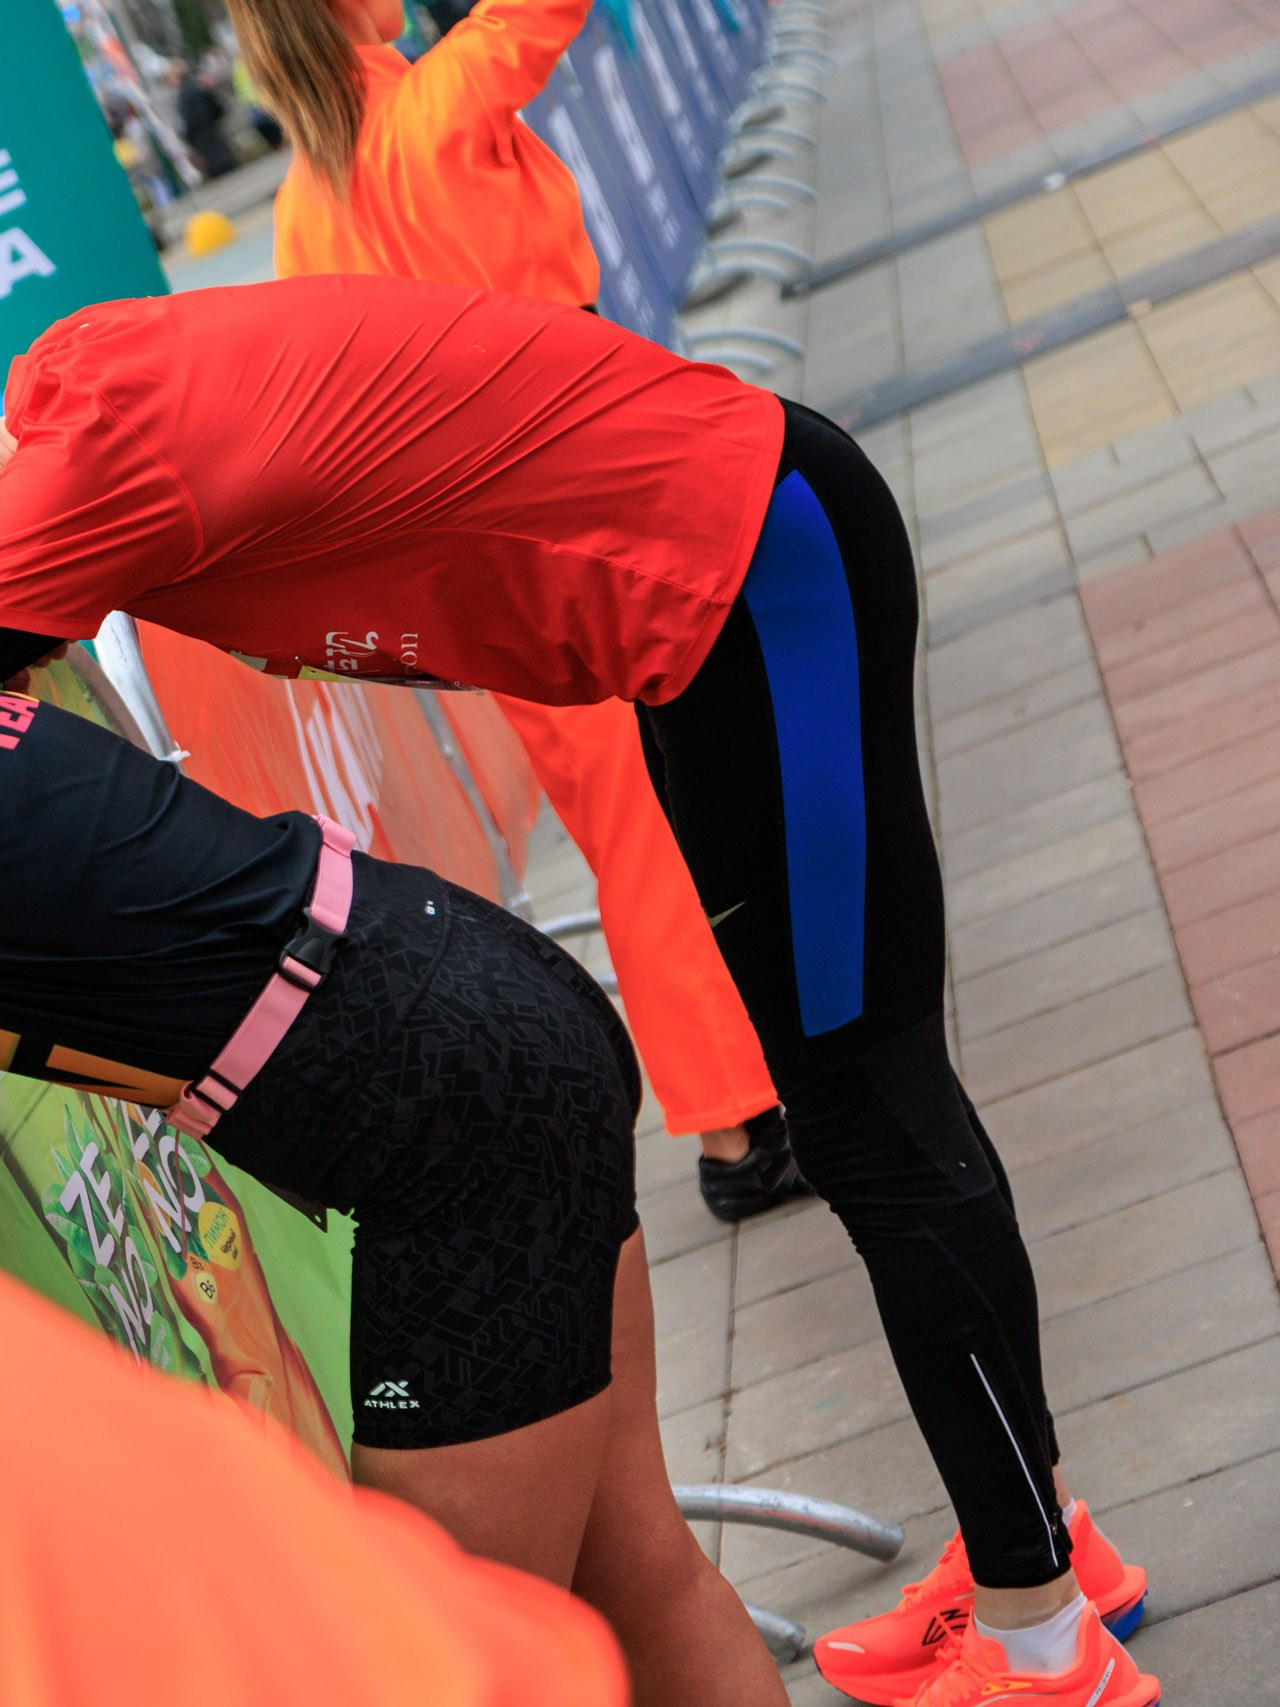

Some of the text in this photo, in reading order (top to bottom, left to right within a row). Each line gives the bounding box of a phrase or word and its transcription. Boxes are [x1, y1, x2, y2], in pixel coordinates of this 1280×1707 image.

[143, 1135, 205, 1253] NO
[109, 1236, 153, 1367] NO
[364, 1399, 420, 1409] ATHLEX
